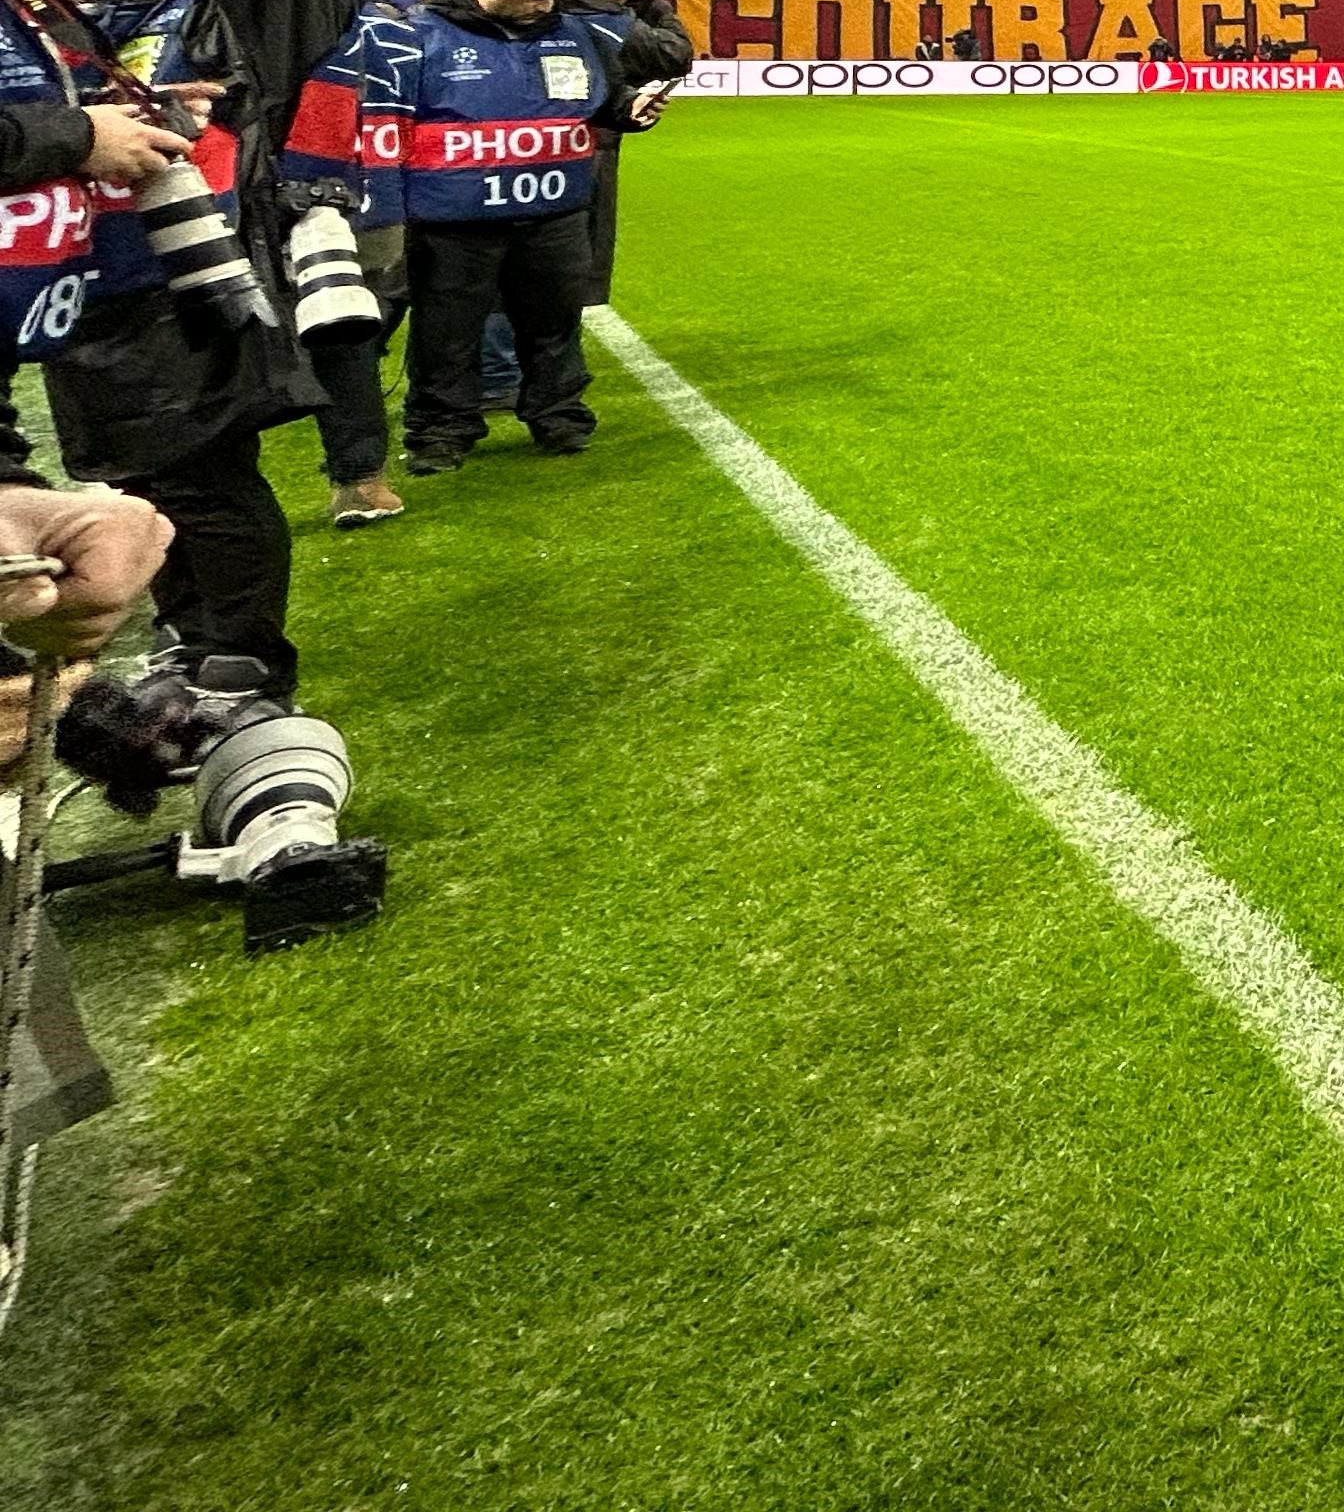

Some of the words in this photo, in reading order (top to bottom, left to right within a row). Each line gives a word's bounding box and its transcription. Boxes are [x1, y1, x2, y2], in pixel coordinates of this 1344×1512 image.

[761, 63, 934, 96] oppo
[970, 63, 1119, 94] oppo
[1191, 65, 1313, 92] TURKISH
[443, 124, 590, 162] PHOTO
[482, 170, 566, 206] 100
